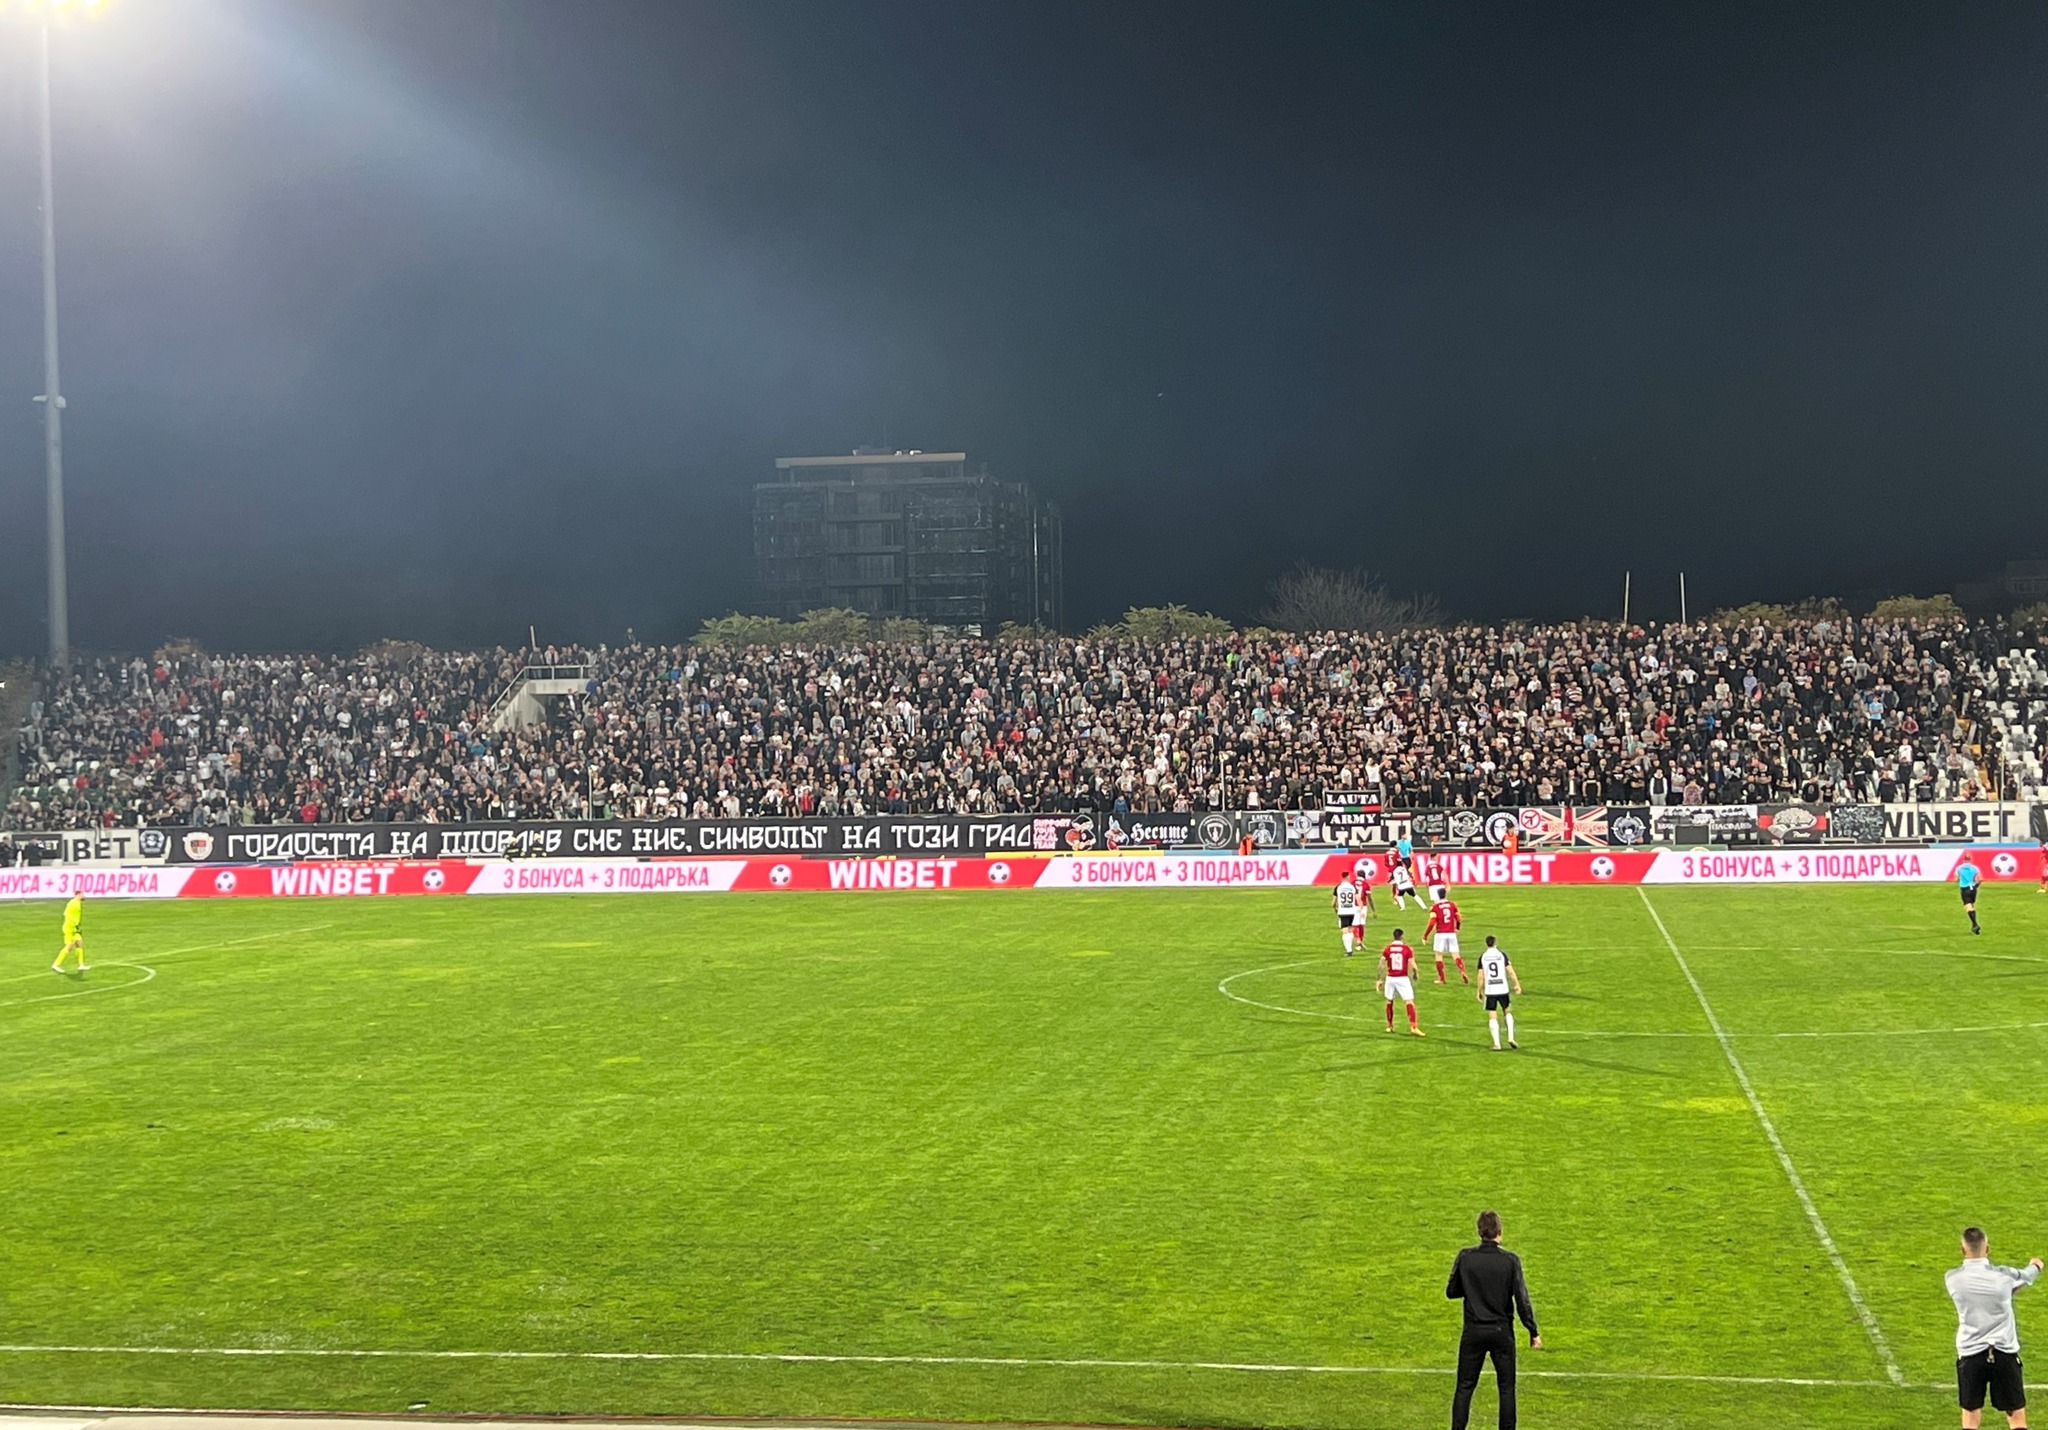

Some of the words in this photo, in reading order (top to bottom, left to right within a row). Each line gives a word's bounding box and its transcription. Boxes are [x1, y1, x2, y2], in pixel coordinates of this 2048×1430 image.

[1326, 794, 1379, 804] LAUTA
[1330, 814, 1376, 824] ARMY
[228, 832, 374, 857] ГОРДОСТТА
[390, 832, 428, 854] НА
[573, 828, 622, 852] СМЕ
[632, 828, 692, 851] НИЕ,
[699, 826, 827, 850] СИМВОЛЪТ
[842, 825, 880, 848] НА
[891, 824, 959, 848] ТОЗИ
[969, 824, 1031, 848] ГРАД
[504, 869, 514, 888] 3
[518, 868, 584, 888] БОНУСА
[604, 868, 614, 887] 3
[619, 866, 709, 889] ПОДАРЪКА
[828, 862, 958, 888] WINBET
[1072, 864, 1082, 882] 3
[1088, 863, 1156, 882] БОНУСА
[1178, 862, 1188, 882] 3
[1194, 860, 1290, 884] ПОДАРЪКА
[1416, 854, 1556, 883] WINBET
[1683, 856, 1694, 878] 3
[1700, 856, 1776, 878] БОНУСА
[1800, 855, 1810, 876] 3
[1816, 854, 1921, 879] ПОДАРЪКА
[73, 872, 158, 894] ПОДАРЪКА
[271, 868, 394, 894] WINBET
[1340, 892, 1354, 904] 99
[1443, 908, 1451, 923] 2
[1390, 953, 1404, 970] 19
[1488, 962, 1498, 978] 9
